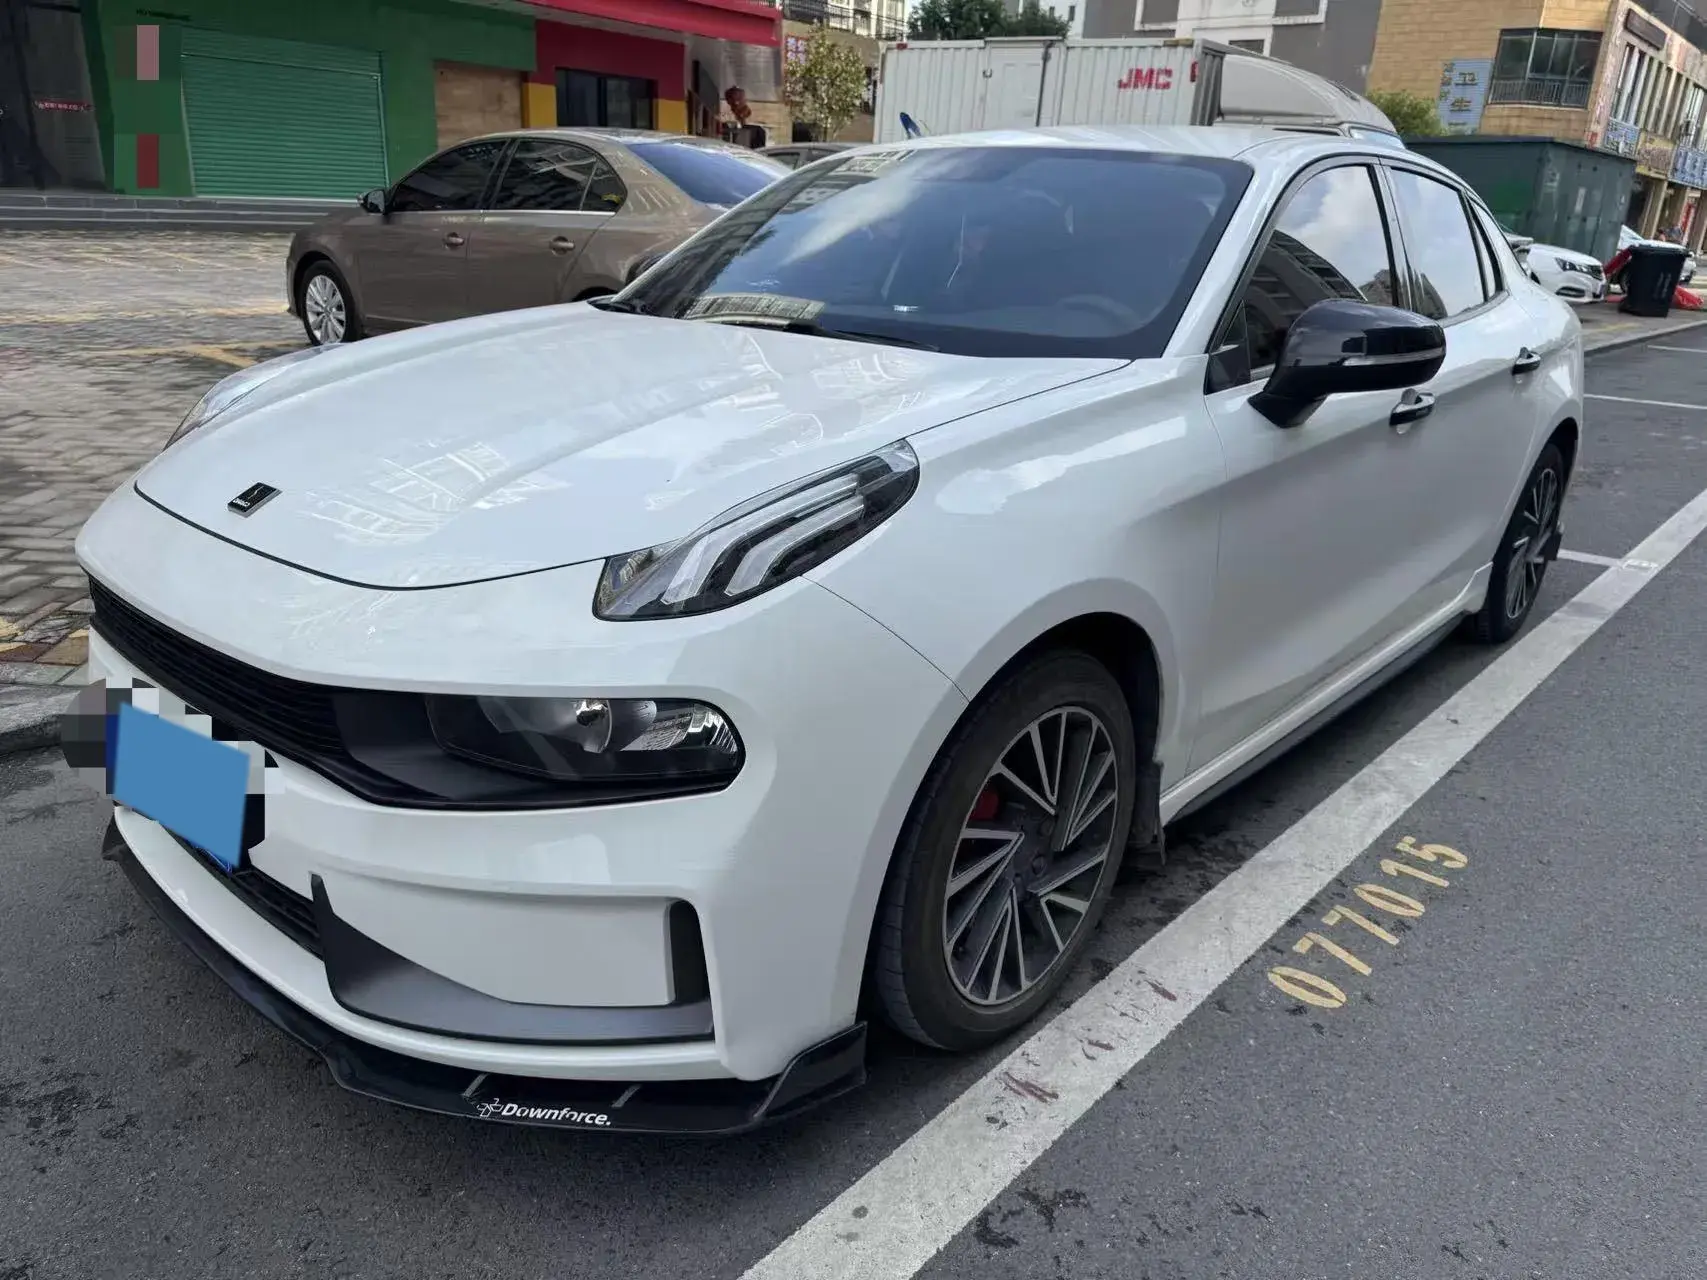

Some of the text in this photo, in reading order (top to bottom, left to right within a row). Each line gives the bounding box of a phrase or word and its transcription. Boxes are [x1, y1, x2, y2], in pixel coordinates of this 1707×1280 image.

[1118, 67, 1173, 89] JMC
[1448, 72, 1478, 127] 卫生
[1267, 835, 1468, 1008] 077015
